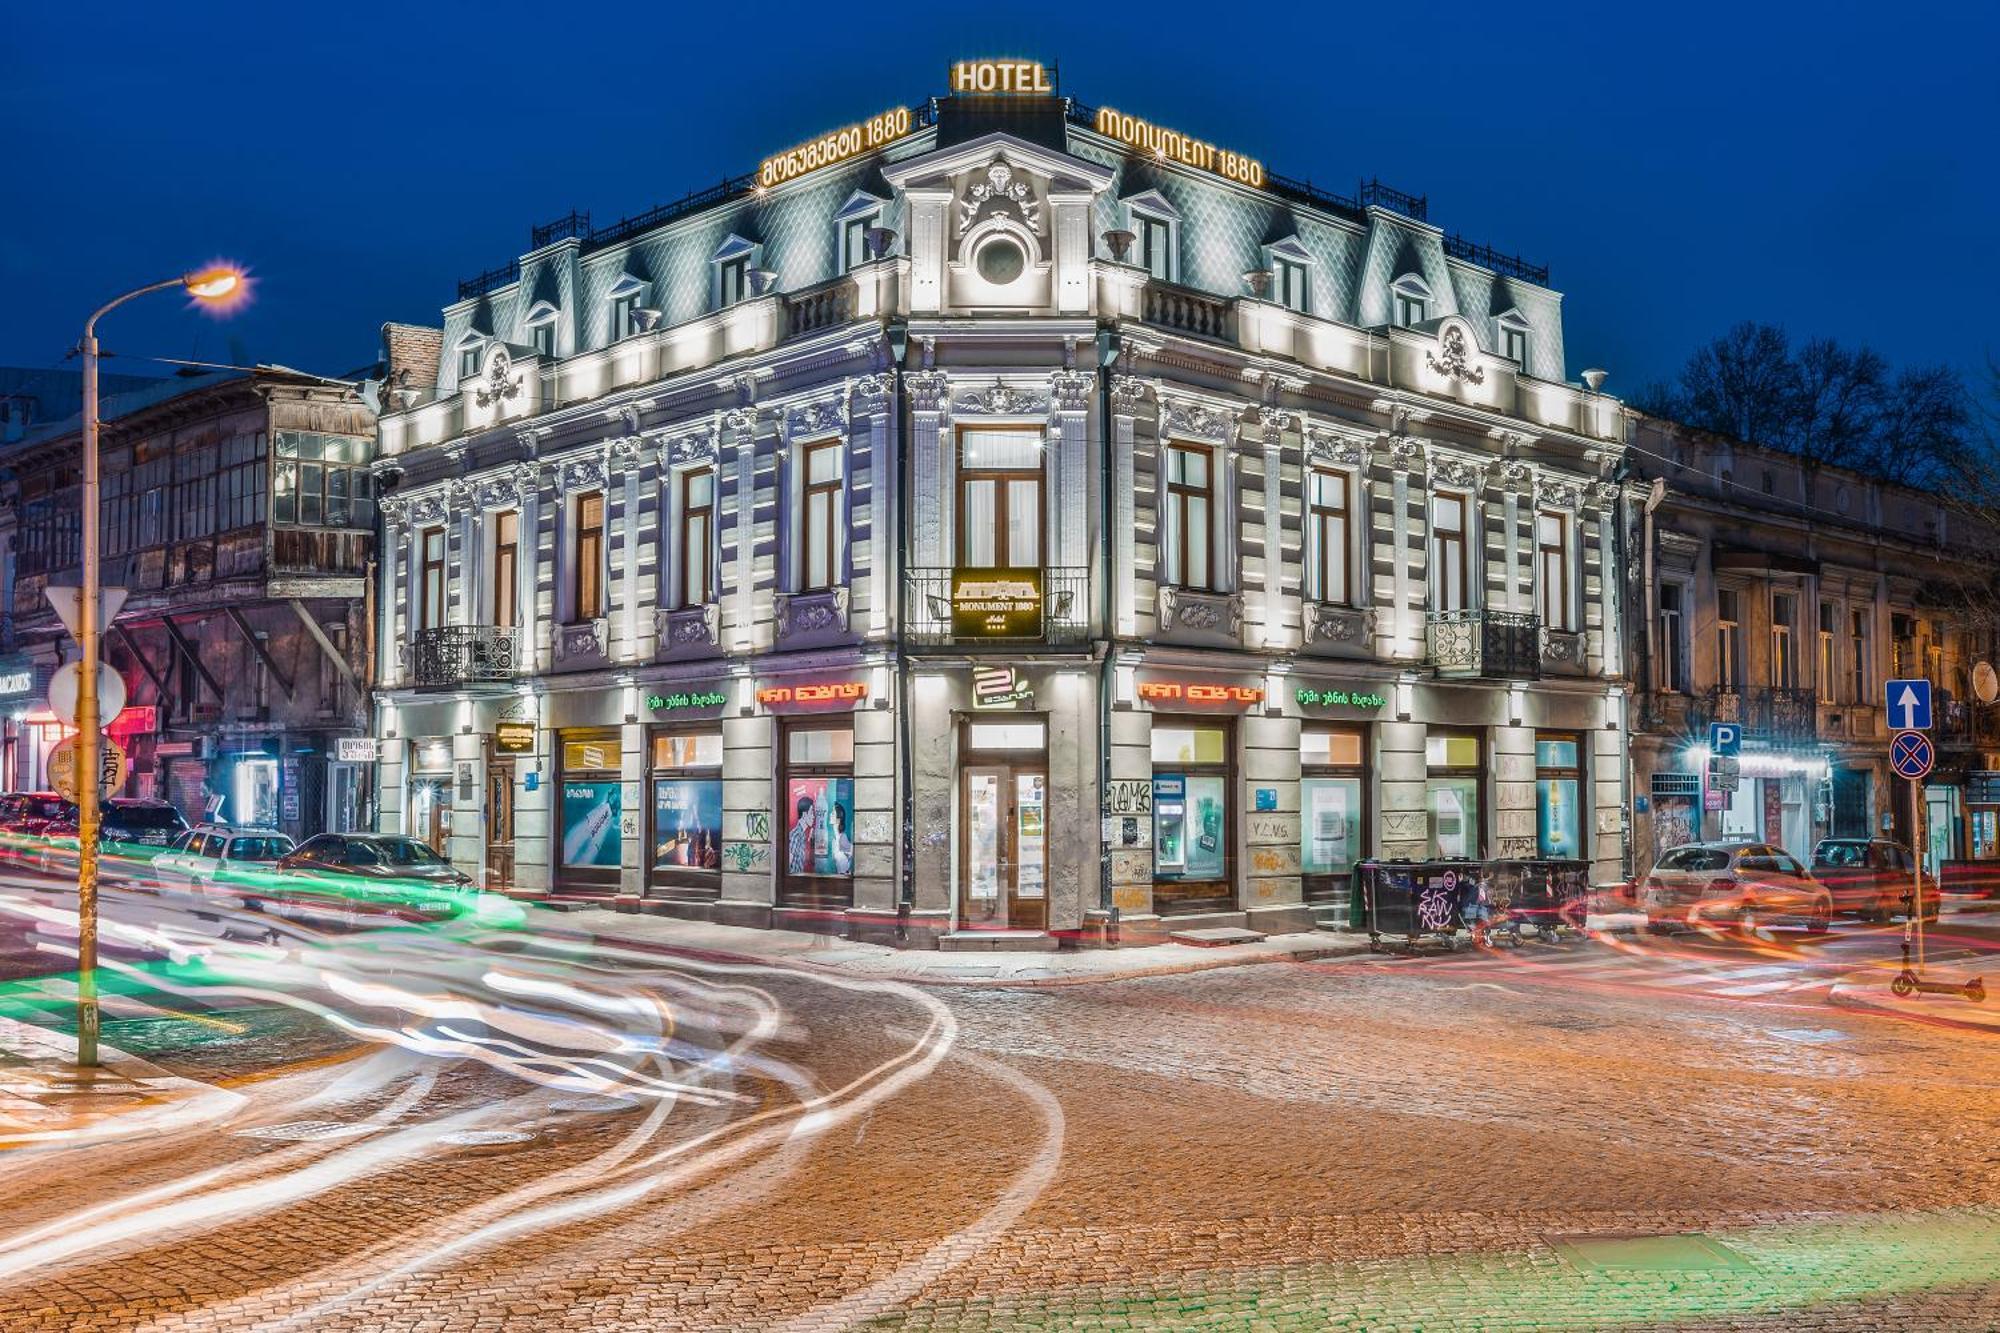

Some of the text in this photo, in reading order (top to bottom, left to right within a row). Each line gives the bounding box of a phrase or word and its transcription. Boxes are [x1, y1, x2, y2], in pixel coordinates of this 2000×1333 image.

[958, 63, 1051, 91] HOTEL
[762, 108, 908, 186] მონუმენტი 1880
[1099, 109, 1262, 187] MONUMENT 1880
[960, 602, 1013, 611] MONUMENT
[1717, 727, 1734, 752] P
